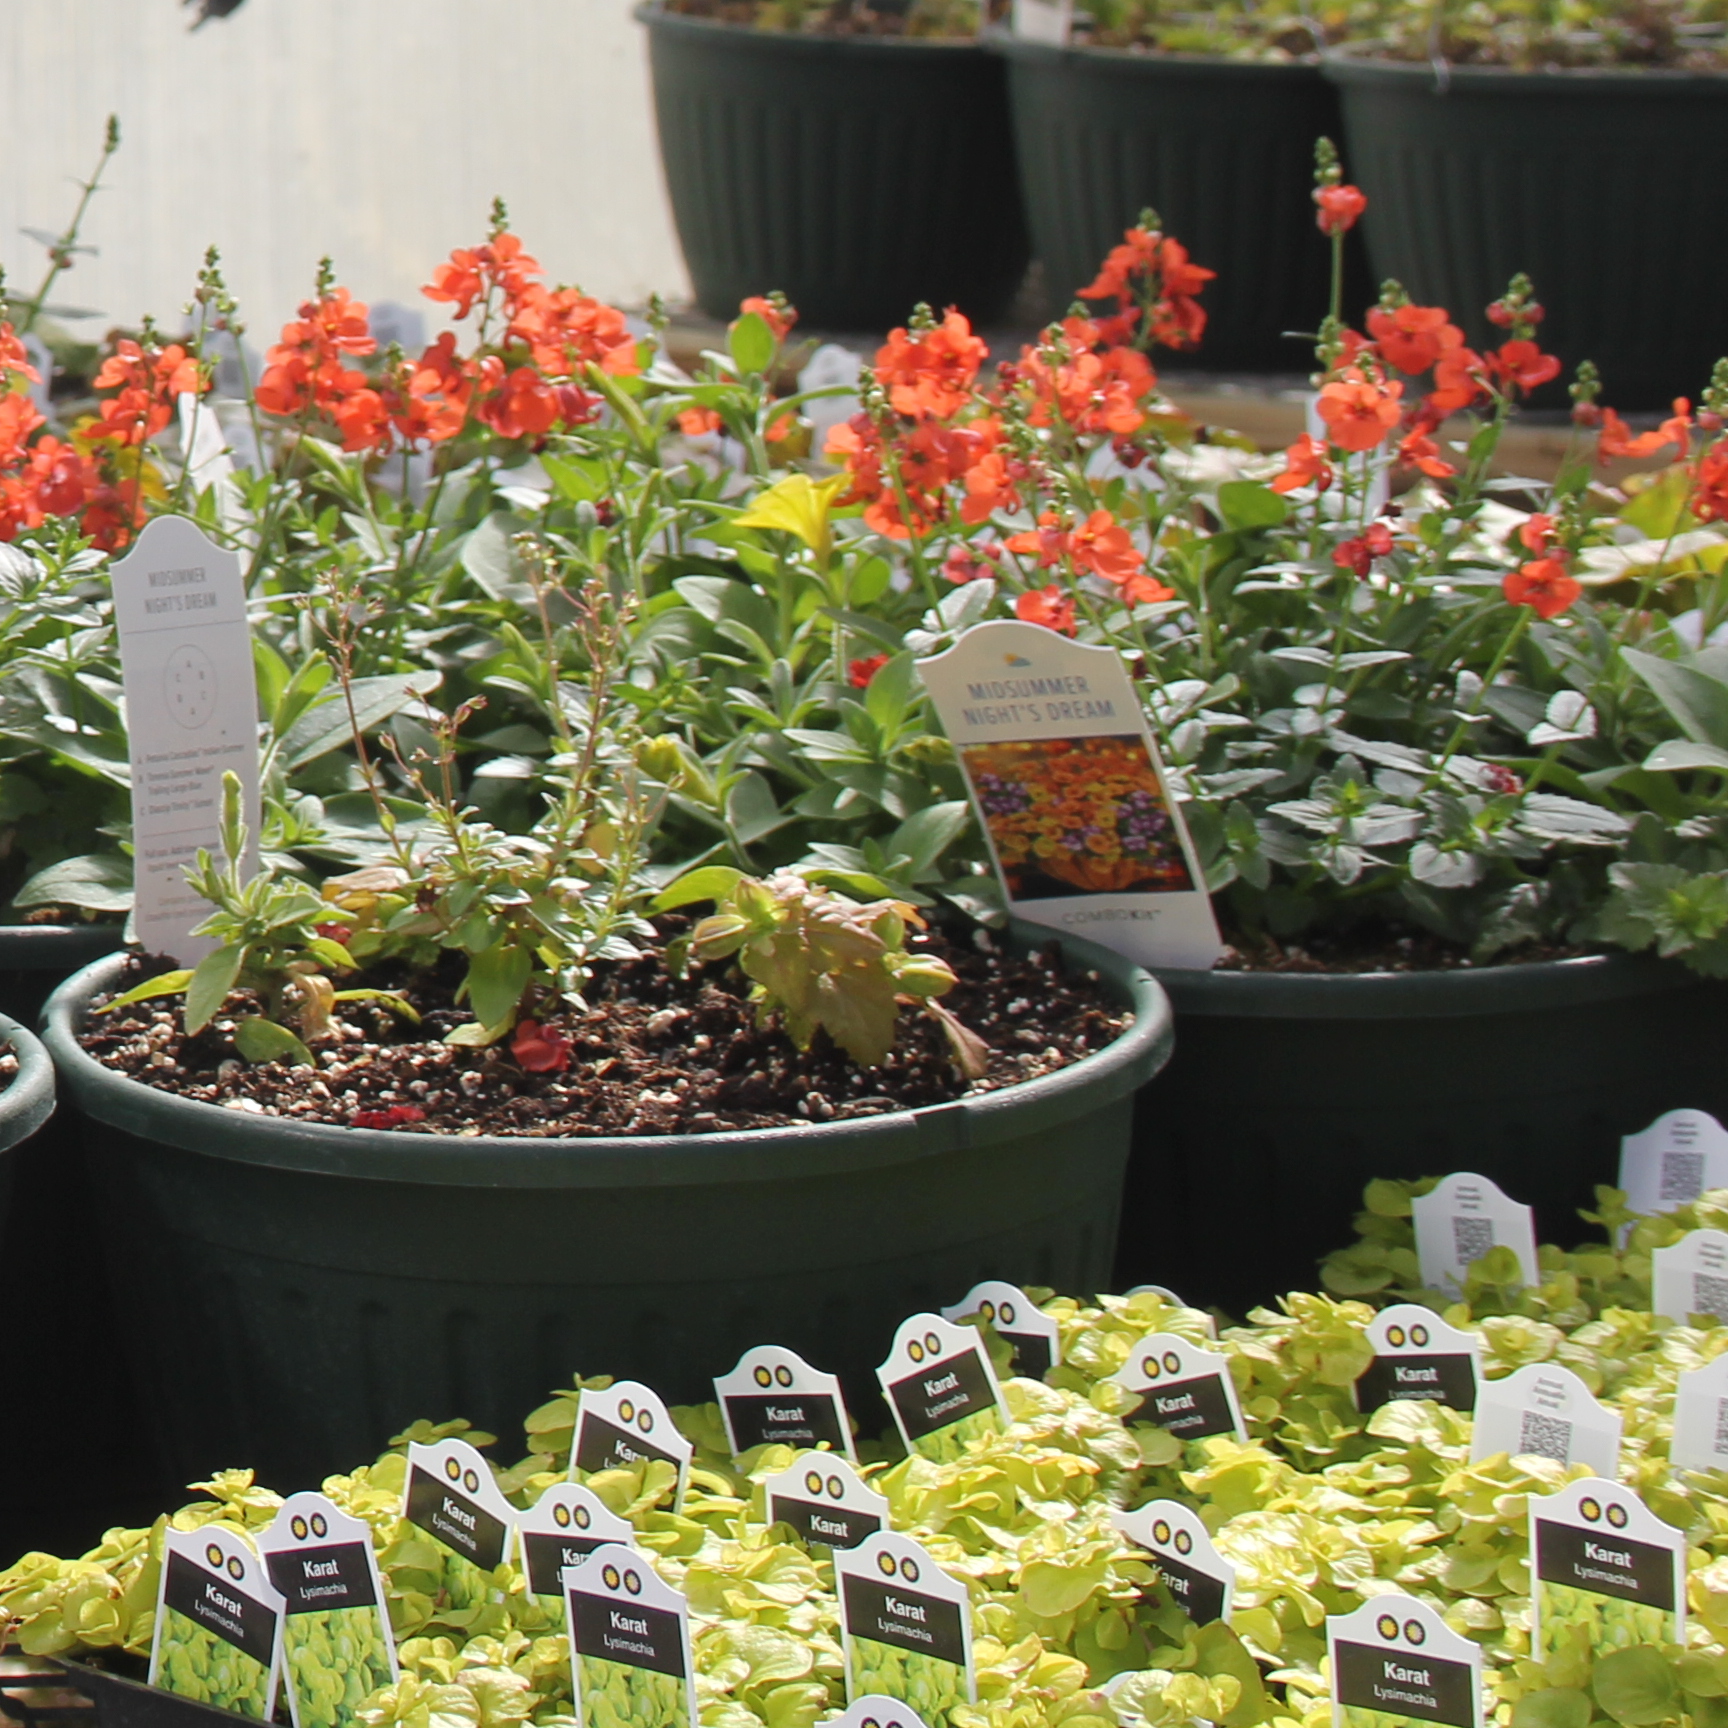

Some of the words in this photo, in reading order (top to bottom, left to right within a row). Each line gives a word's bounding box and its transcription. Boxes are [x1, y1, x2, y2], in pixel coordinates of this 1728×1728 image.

[967, 675, 1090, 701] MIDSUMMER
[962, 703, 1041, 726] NIGHT'S
[1046, 699, 1117, 721] DREAM
[924, 1372, 959, 1397] Karat
[1395, 1366, 1438, 1383] Karat
[765, 1406, 806, 1421] Karat
[924, 1392, 970, 1419] Lysimachia
[1155, 1393, 1195, 1414] Karat
[761, 1428, 814, 1440] Lysimachia
[443, 1496, 476, 1532] Karat
[810, 1514, 848, 1538] Karat
[432, 1513, 477, 1551] Lysimachia
[1584, 1541, 1632, 1569] Karat
[303, 1559, 339, 1578] Karat
[1573, 1562, 1638, 1590] Lysimachia
[205, 1582, 243, 1618] Karat
[300, 1582, 348, 1601] Lysimachia
[194, 1599, 244, 1639] Lysimachia
[885, 1595, 926, 1622] Karat
[610, 1610, 649, 1636] Karat
[877, 1617, 933, 1643] Lysimachia
[603, 1633, 655, 1657] Lysimachia
[1383, 1660, 1431, 1686] Karat
[1373, 1684, 1438, 1709] Lysimachia
